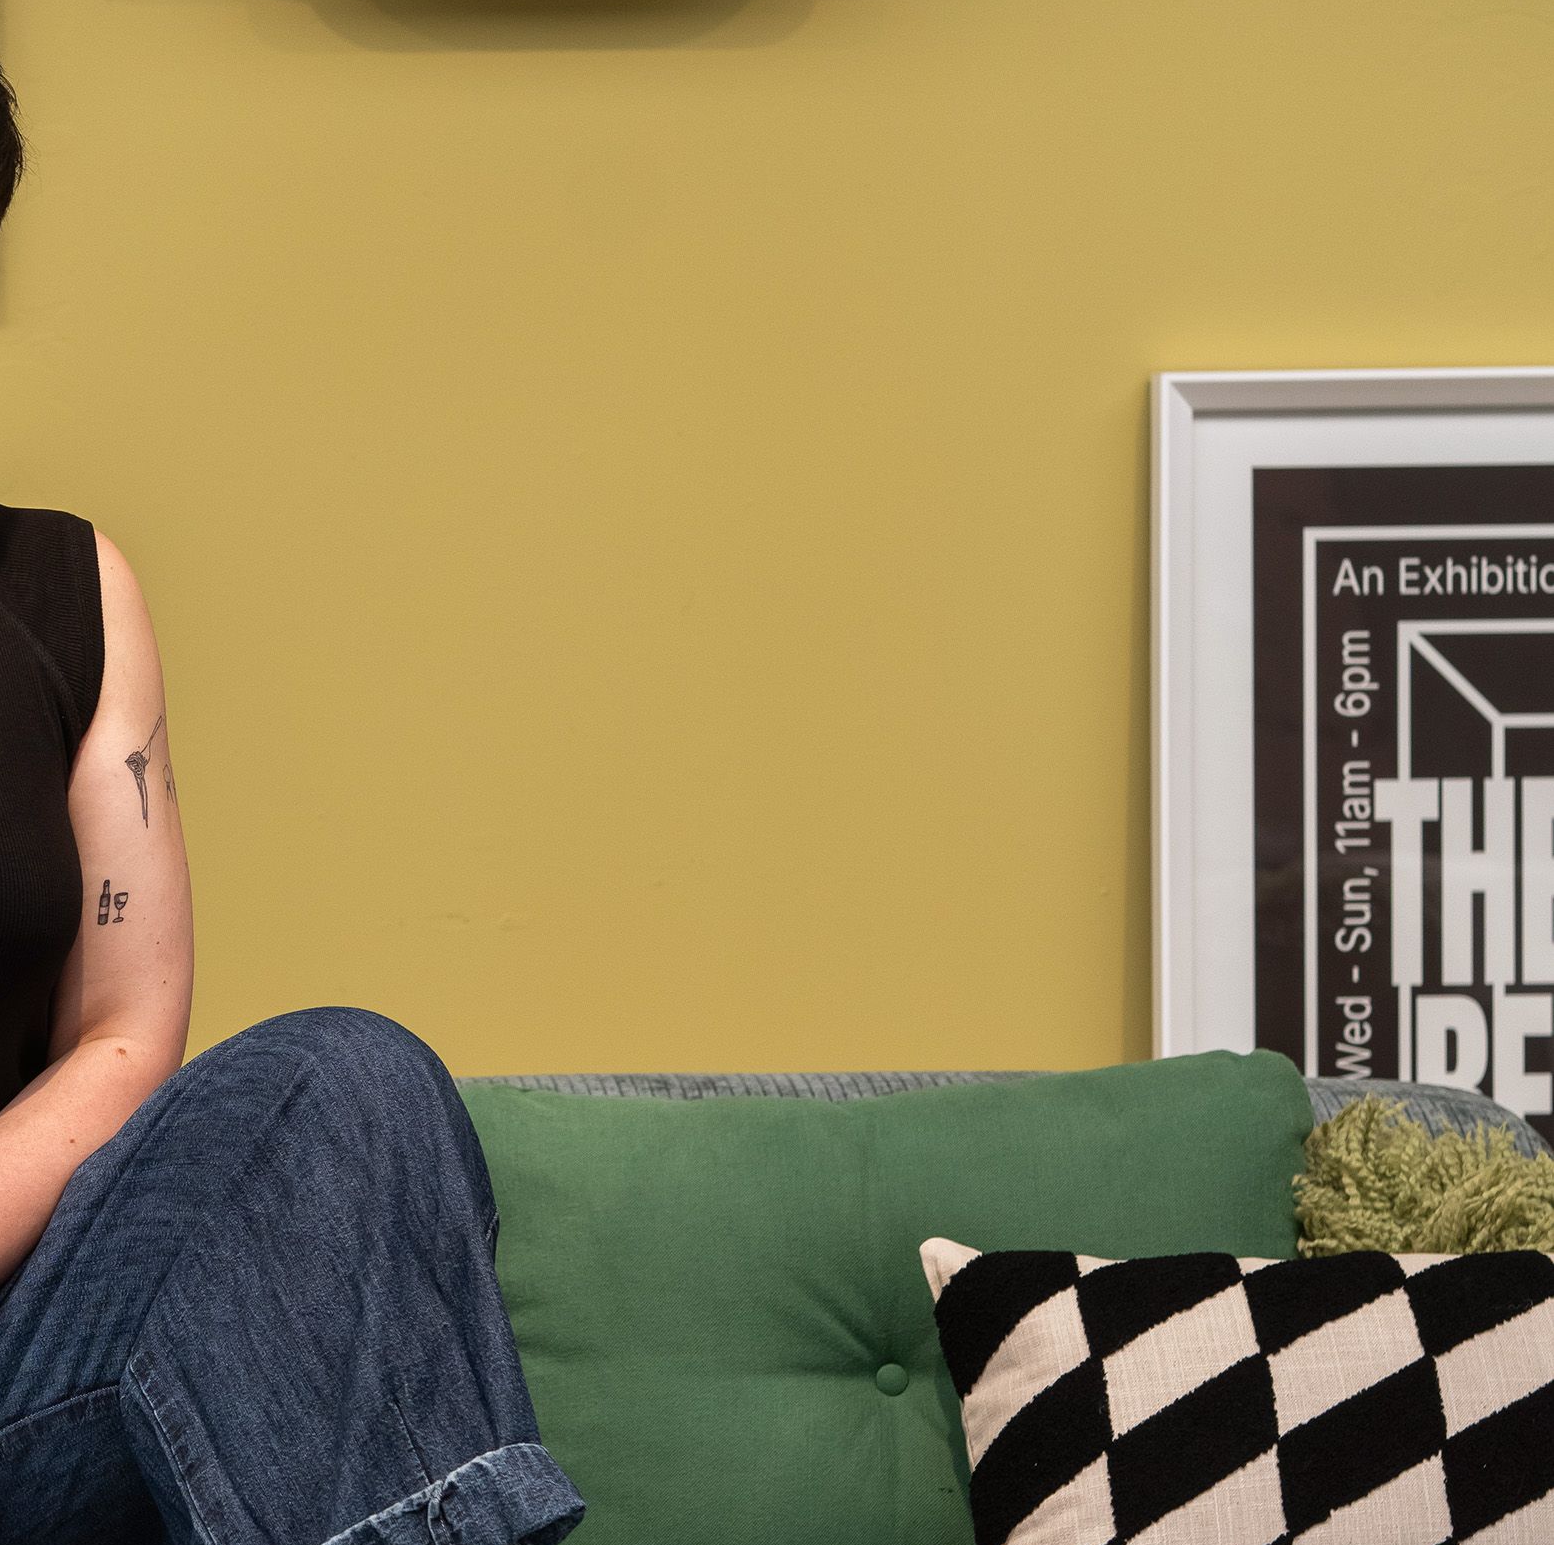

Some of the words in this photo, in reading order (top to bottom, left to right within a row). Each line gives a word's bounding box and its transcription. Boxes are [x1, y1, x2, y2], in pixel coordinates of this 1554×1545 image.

[1332, 557, 1385, 597] An
[1334, 630, 1380, 718] 6pm
[1334, 759, 1372, 855] 11am
[1335, 866, 1380, 953] Sun,
[1335, 996, 1372, 1080] Wed
